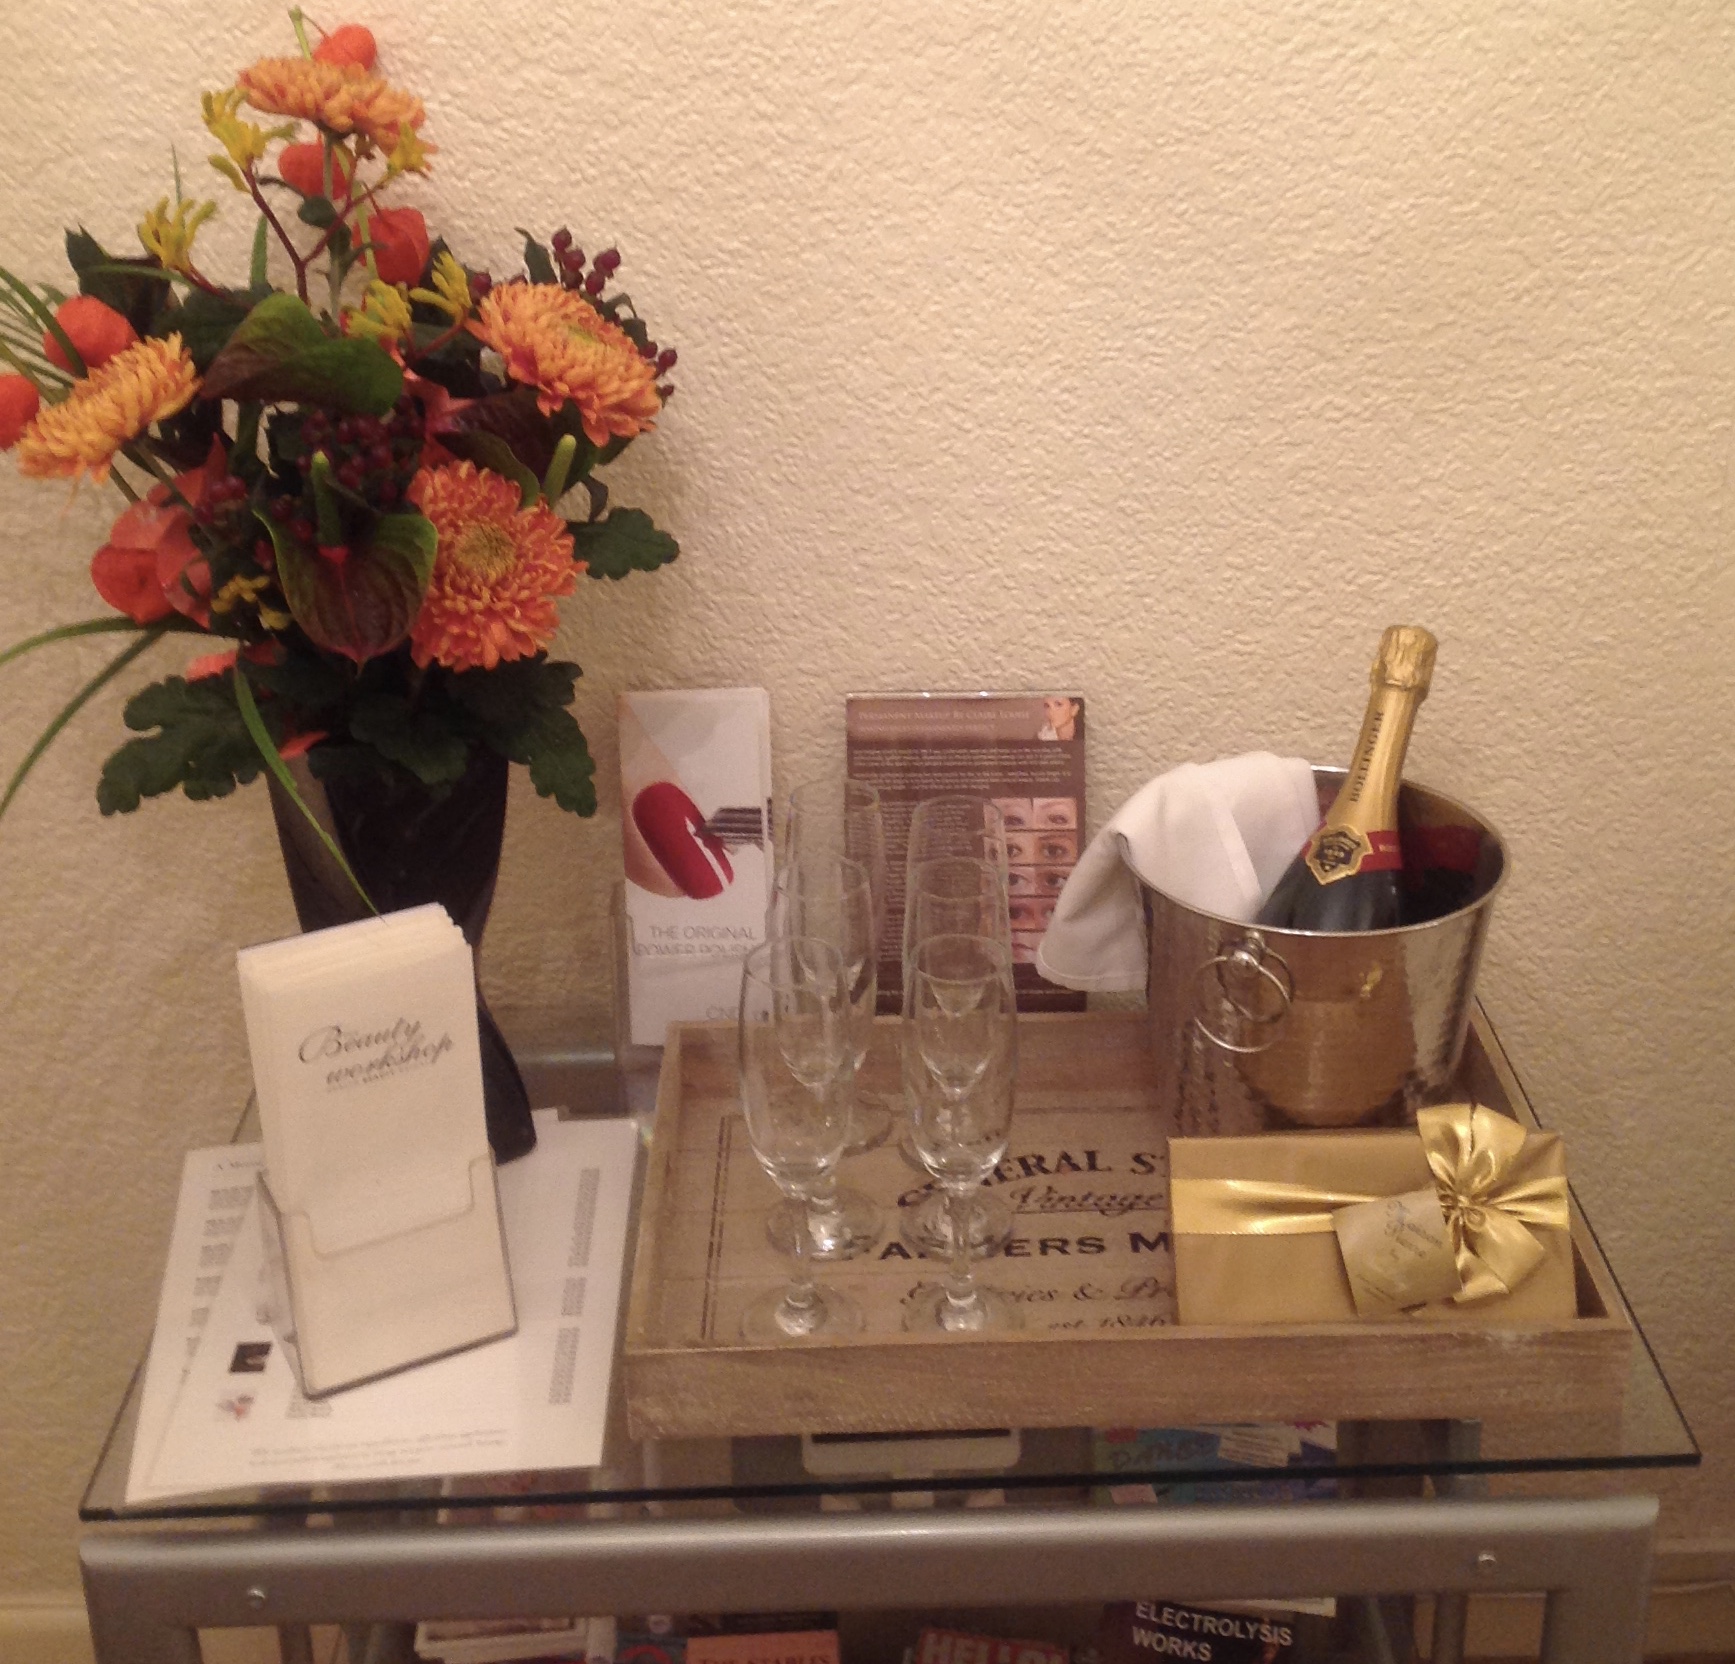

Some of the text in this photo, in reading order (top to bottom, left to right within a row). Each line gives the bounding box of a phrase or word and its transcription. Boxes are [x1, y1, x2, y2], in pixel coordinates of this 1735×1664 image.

[650, 925, 757, 940] THE ORIGINAL
[298, 1017, 426, 1063] Beauty
[1132, 1626, 1212, 1662] WORKS
[1135, 1601, 1293, 1647] ELECTROLYSIS
